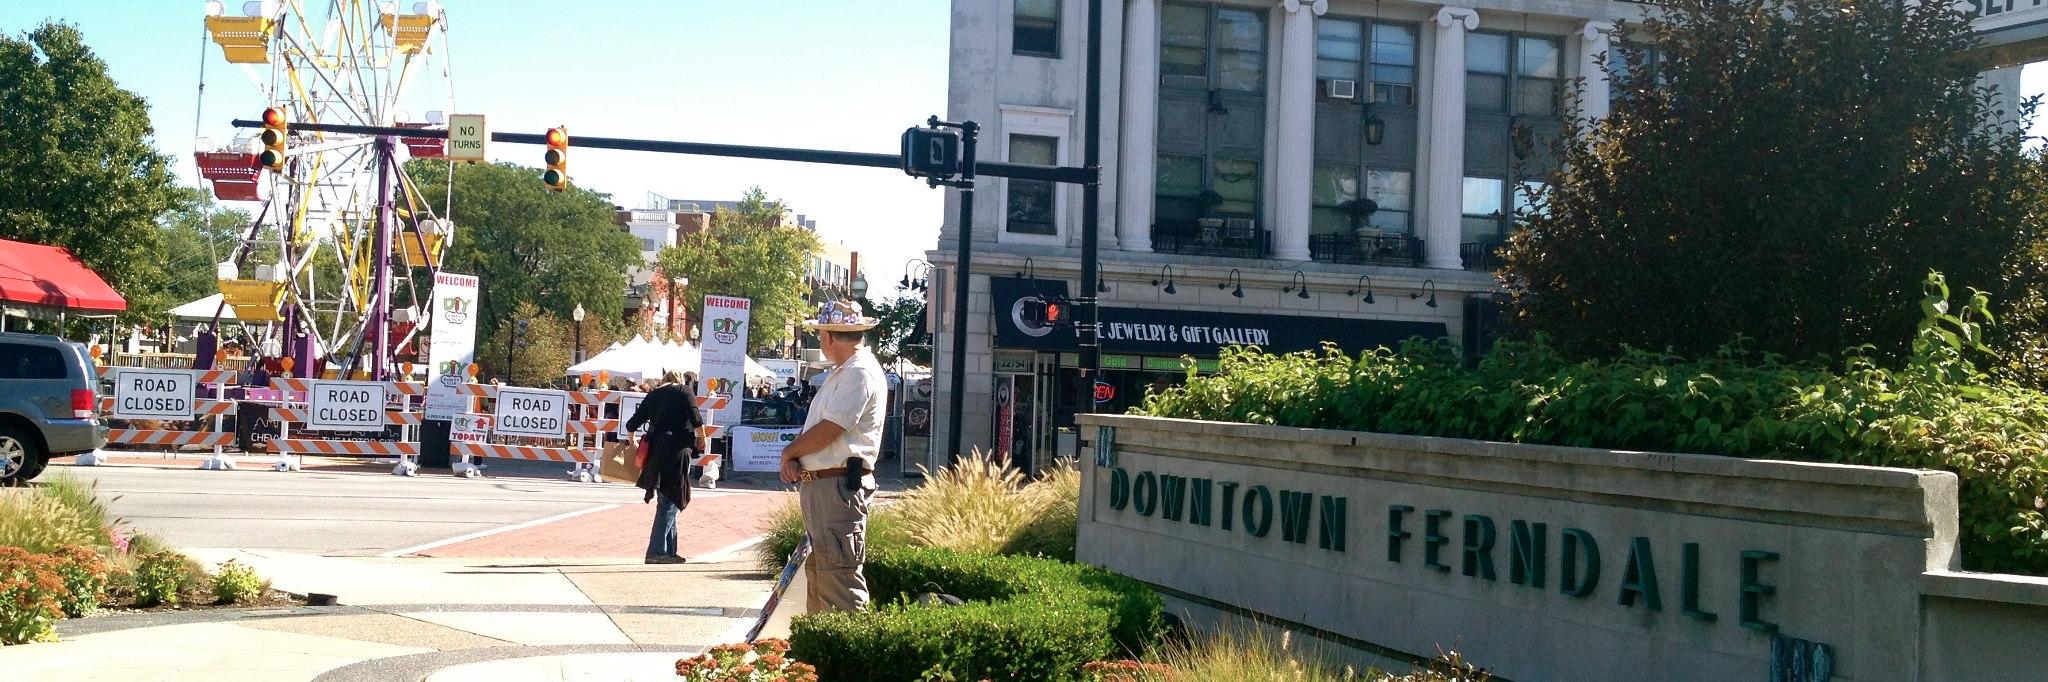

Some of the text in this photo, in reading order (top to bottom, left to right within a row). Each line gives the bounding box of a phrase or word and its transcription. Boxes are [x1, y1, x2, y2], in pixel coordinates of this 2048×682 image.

[460, 126, 475, 136] NO
[453, 140, 481, 149] TURNS
[436, 275, 477, 288] WELCOME
[443, 296, 472, 312] DIY
[706, 297, 749, 310] WELCOME
[713, 317, 743, 333] DIY
[1074, 320, 1270, 346] FE JEWELRY & GIFT GALLERY
[440, 360, 468, 376] DIY
[1104, 356, 1127, 366] Gold
[134, 379, 177, 392] ROAD
[327, 389, 370, 403] ROAD
[124, 397, 185, 411] CLOSED
[512, 398, 551, 412] ROAD
[319, 408, 378, 421] CLOSED
[503, 415, 558, 430] CLOSED
[451, 432, 486, 442] TODAY!
[1110, 467, 1781, 633] DOWNTOWN FERNDALE
